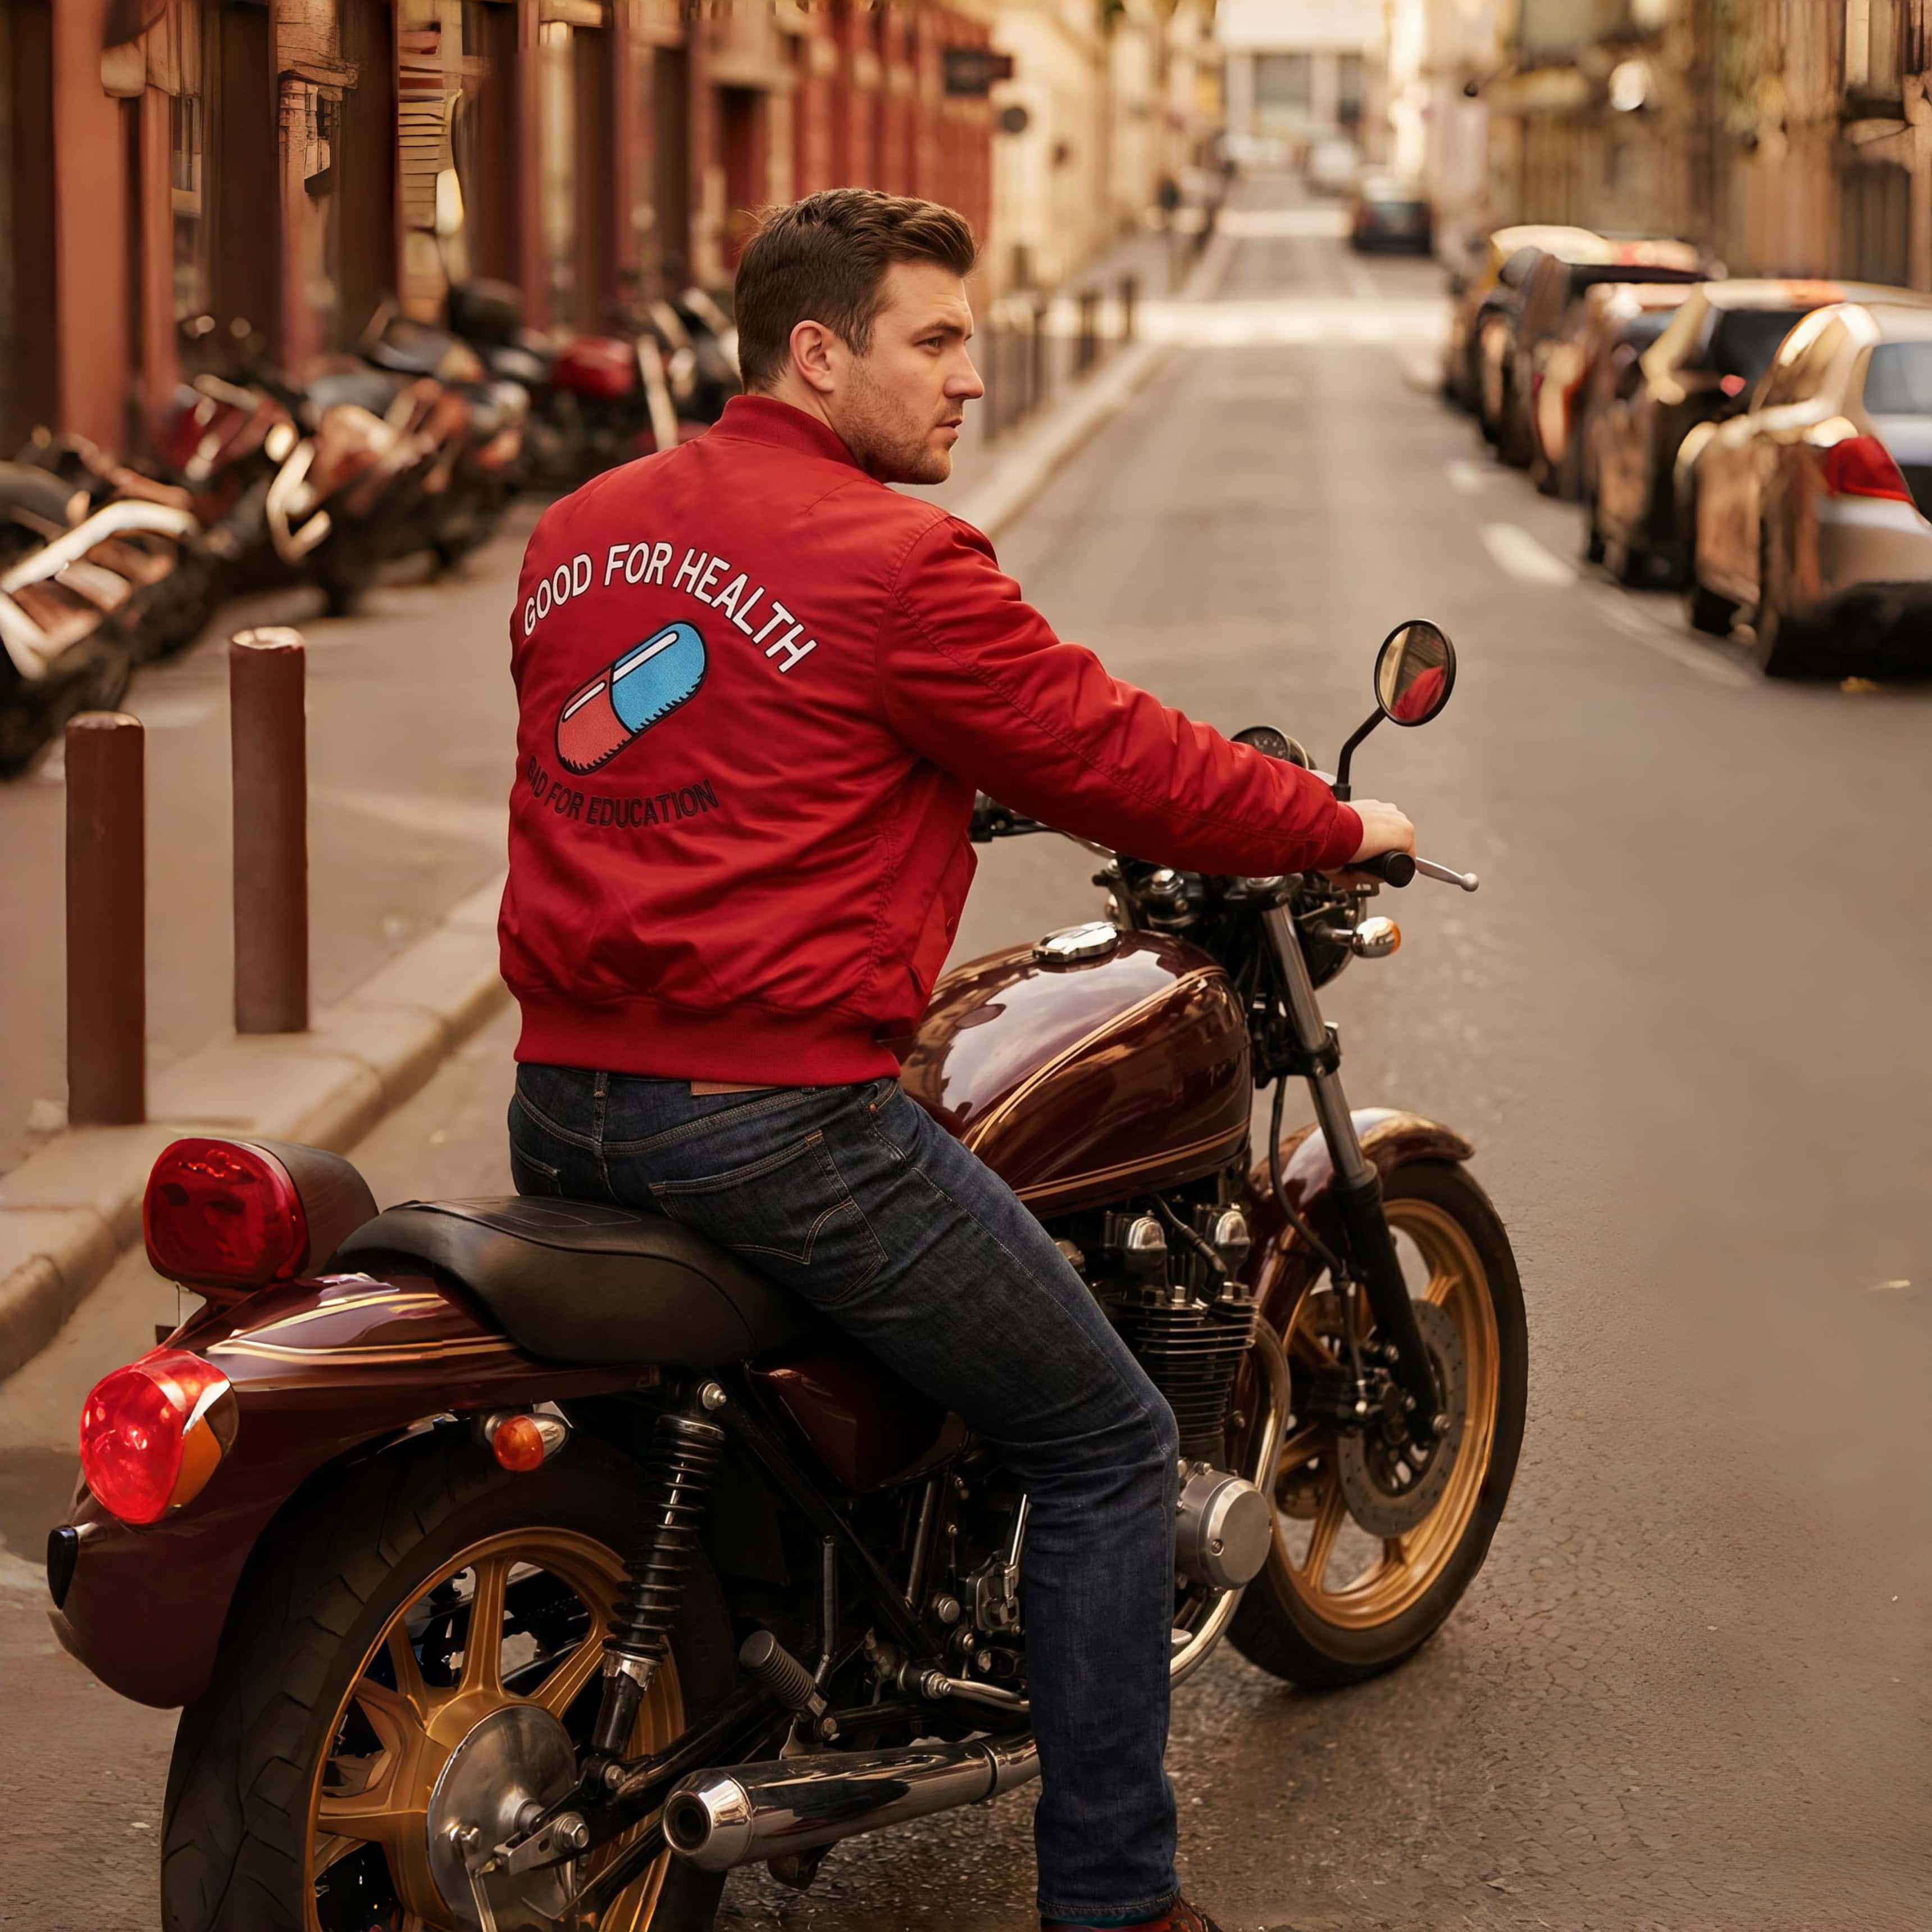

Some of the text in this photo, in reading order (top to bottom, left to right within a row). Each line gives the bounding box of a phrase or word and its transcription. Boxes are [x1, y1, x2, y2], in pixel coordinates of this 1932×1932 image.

[523, 542, 818, 673] GOOD FOR HEALTH
[543, 781, 584, 821] FOR
[585, 778, 719, 828] EDUCATION
